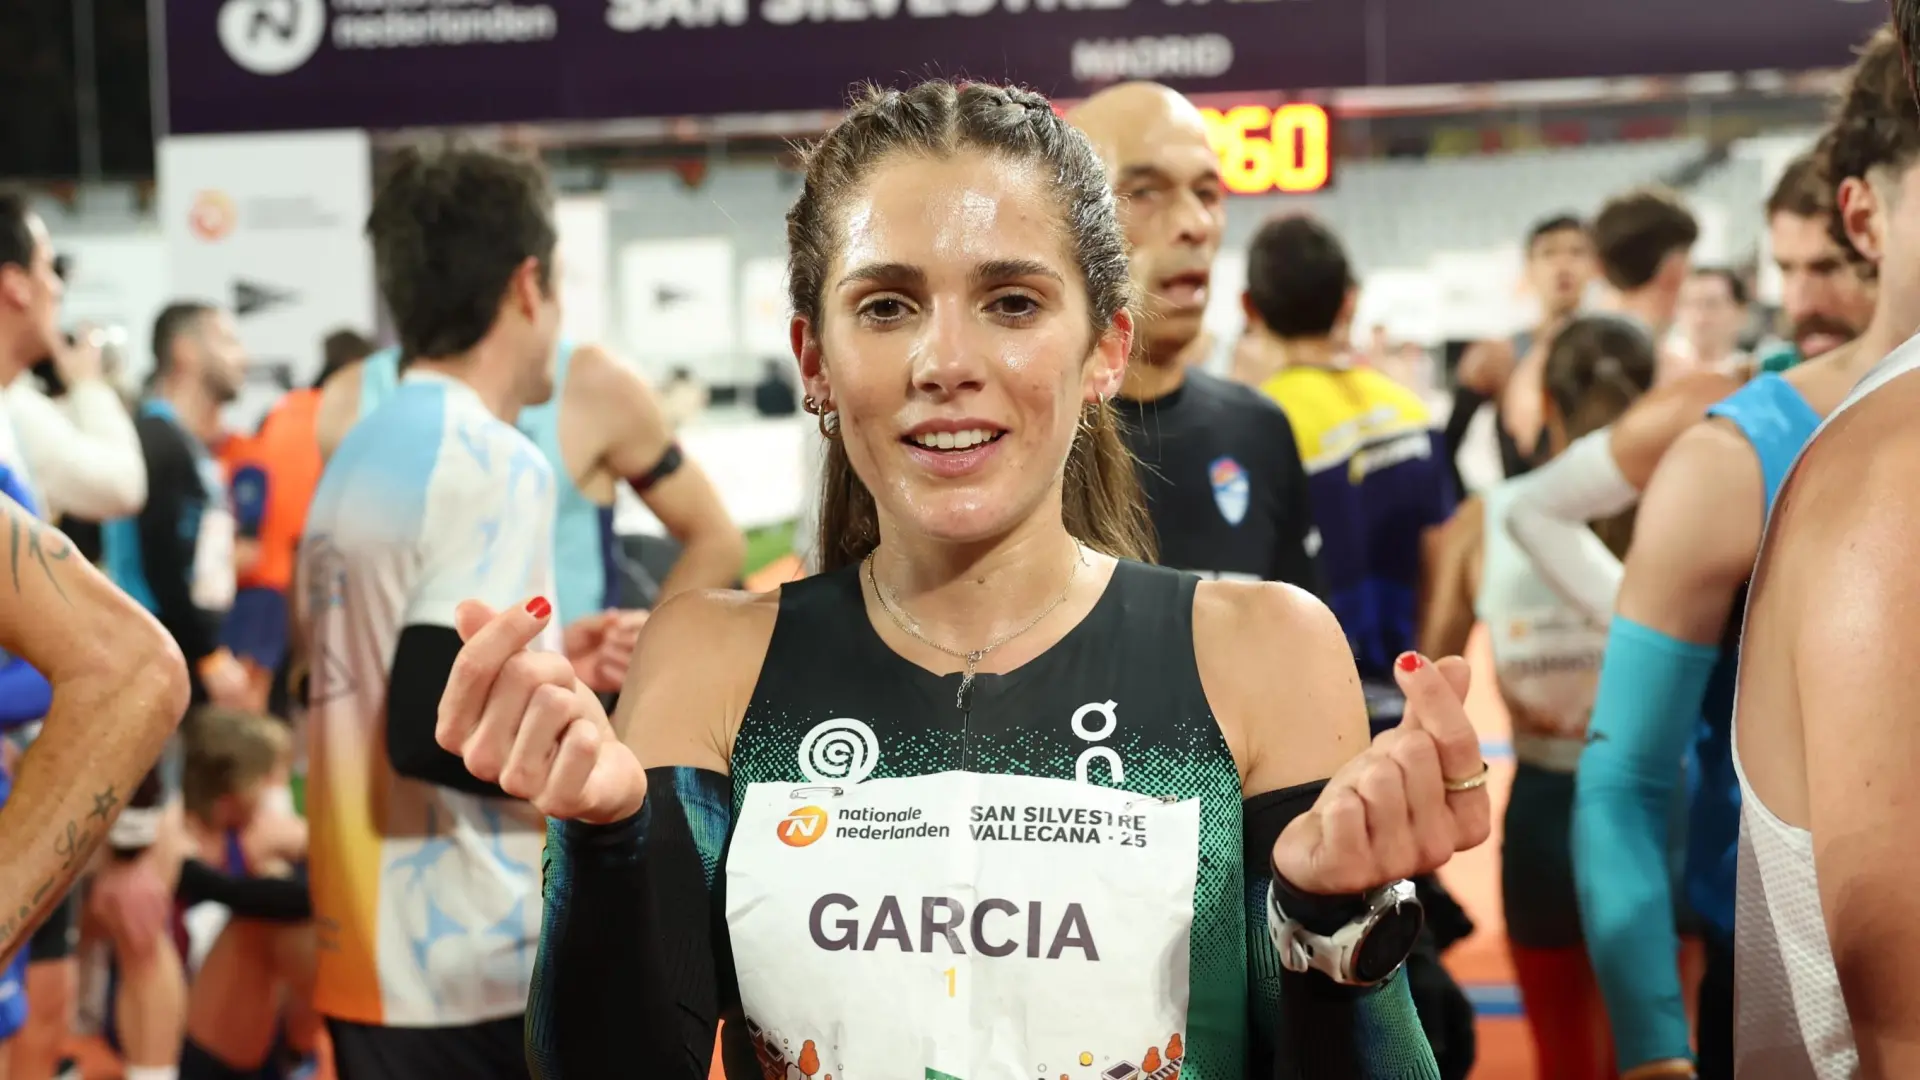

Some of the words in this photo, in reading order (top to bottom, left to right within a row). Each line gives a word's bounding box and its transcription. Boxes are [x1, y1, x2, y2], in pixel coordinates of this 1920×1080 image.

[838, 807, 922, 823] nationale
[969, 805, 1016, 822] SAN
[836, 822, 950, 840] nederlanden
[969, 824, 1101, 844] VALLECANA
[1120, 831, 1148, 848] 25
[808, 893, 1101, 962] GARCIA
[943, 967, 956, 999] 1
